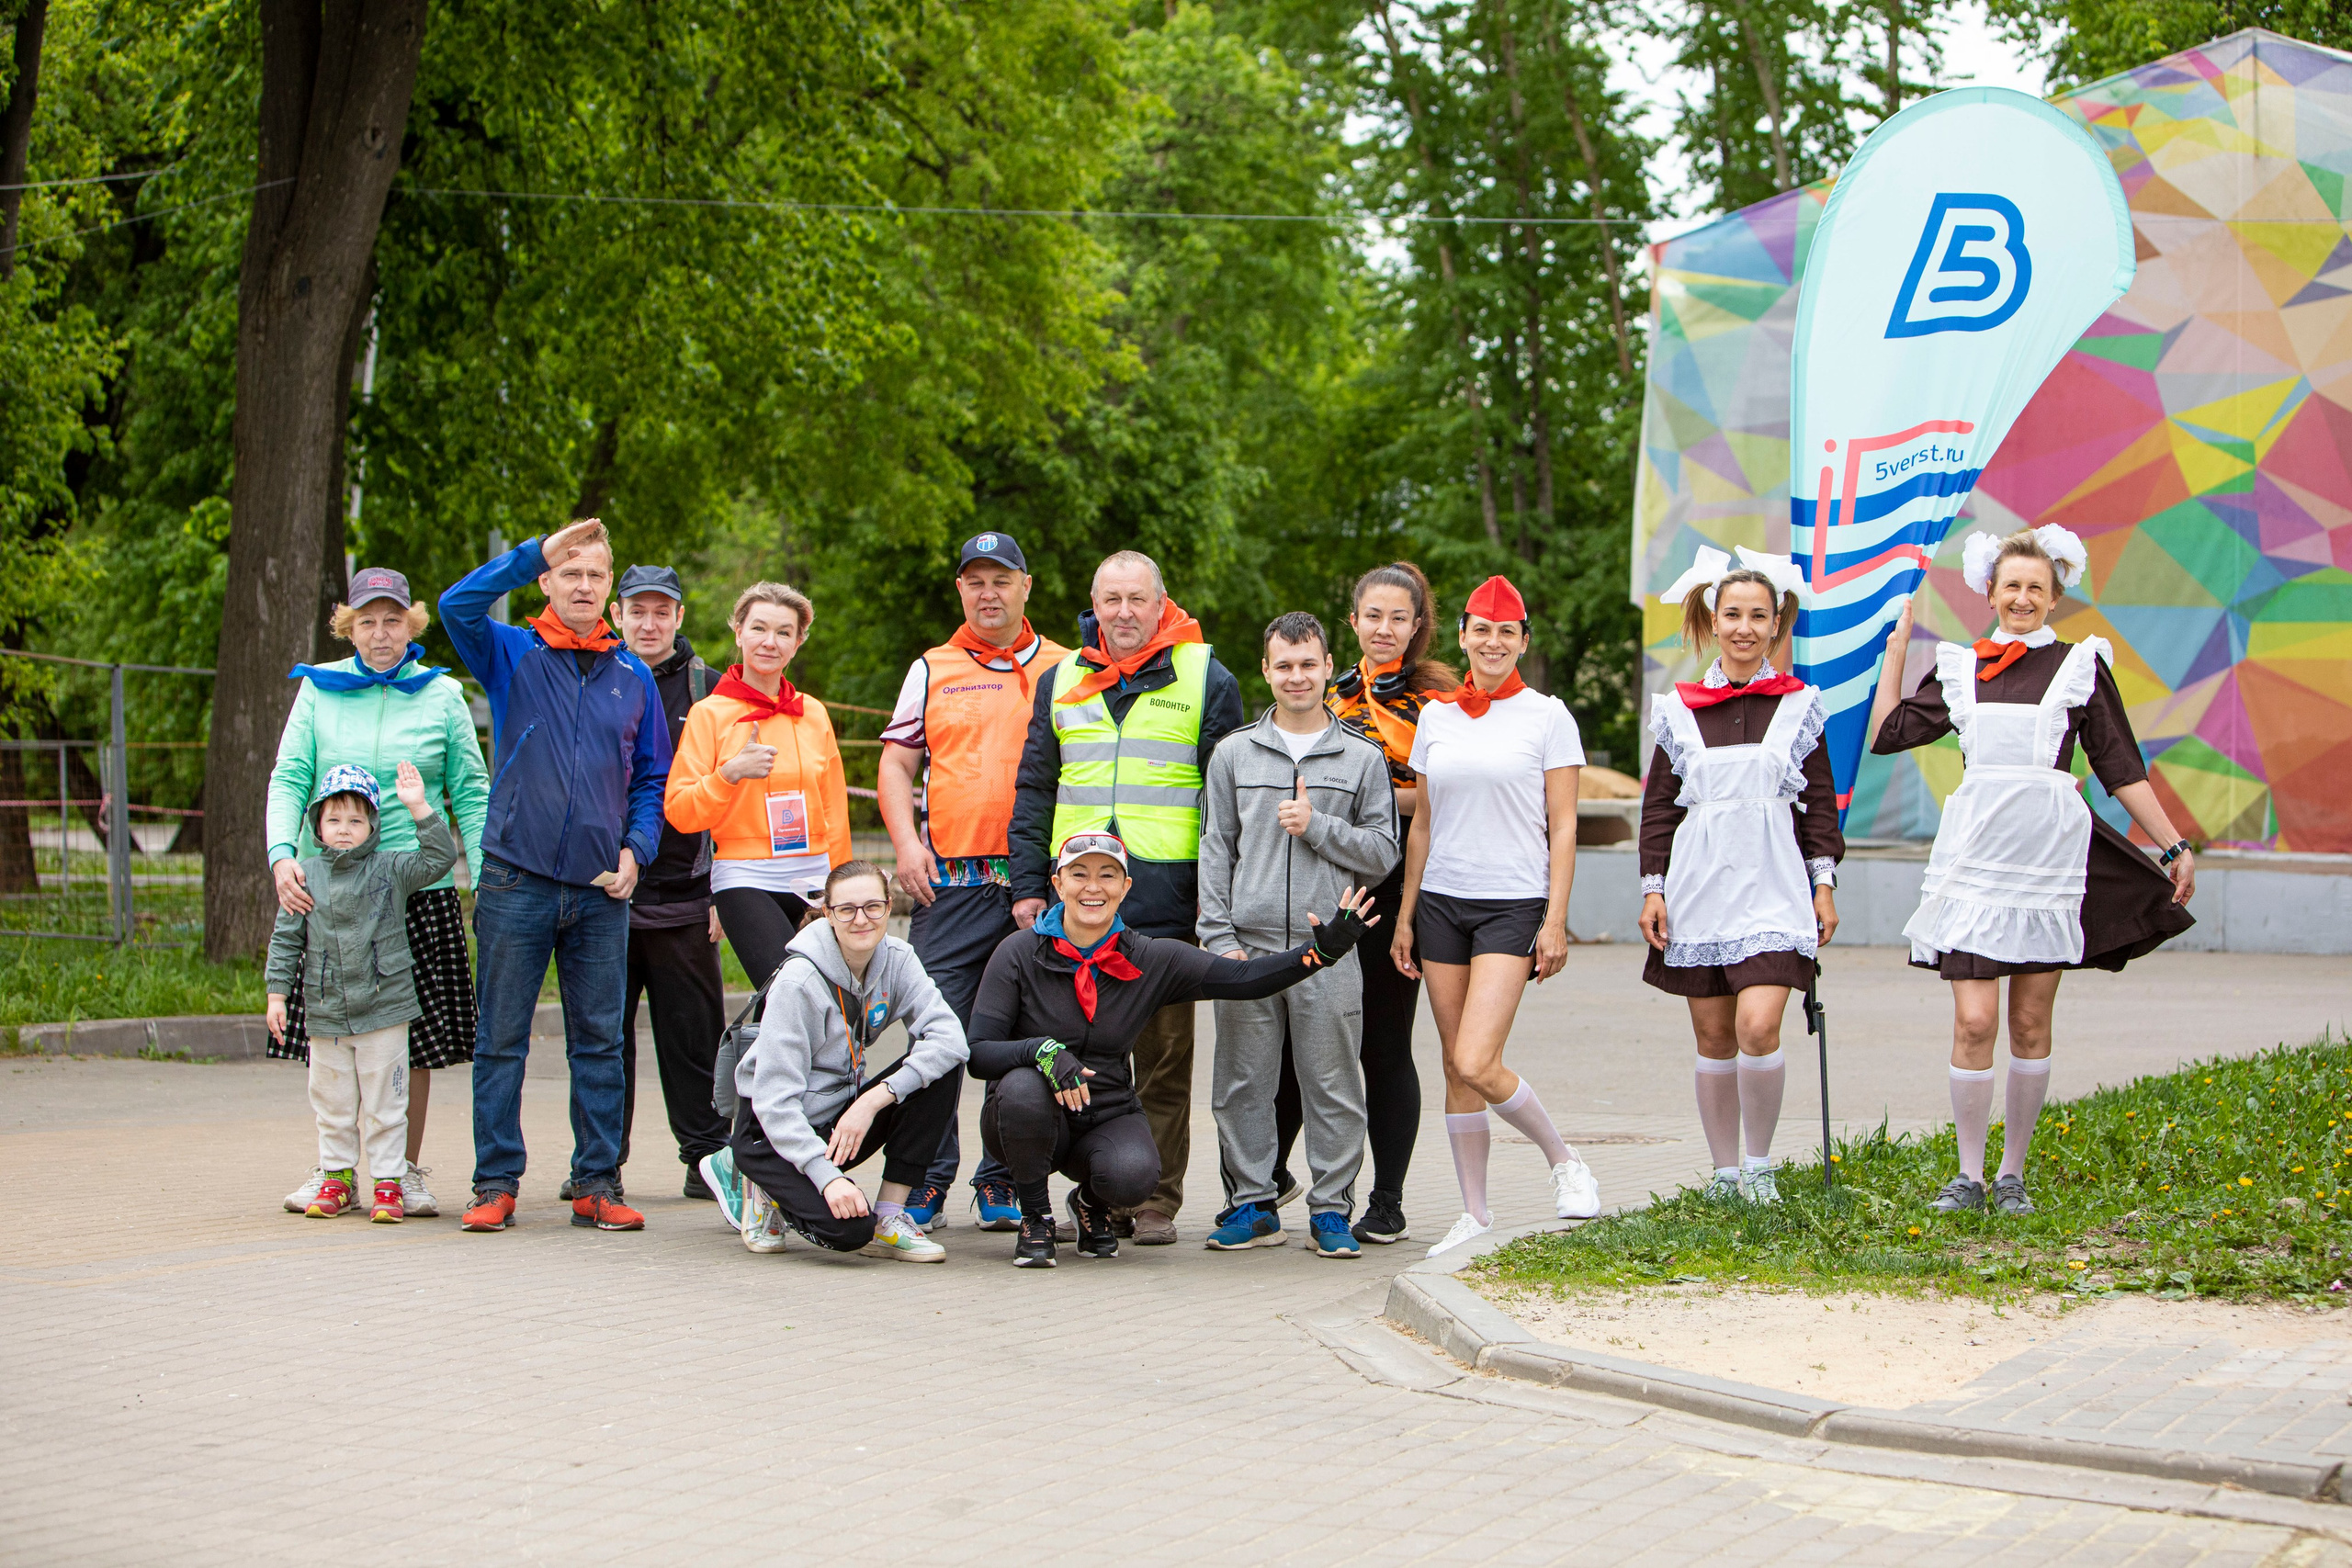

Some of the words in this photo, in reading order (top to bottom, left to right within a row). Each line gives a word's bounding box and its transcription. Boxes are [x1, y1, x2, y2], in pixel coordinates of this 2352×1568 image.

[1875, 444, 1964, 481] 5verst.ru
[943, 683, 1003, 694] Организатор
[1149, 697, 1191, 713] ВОЛОНТЕР
